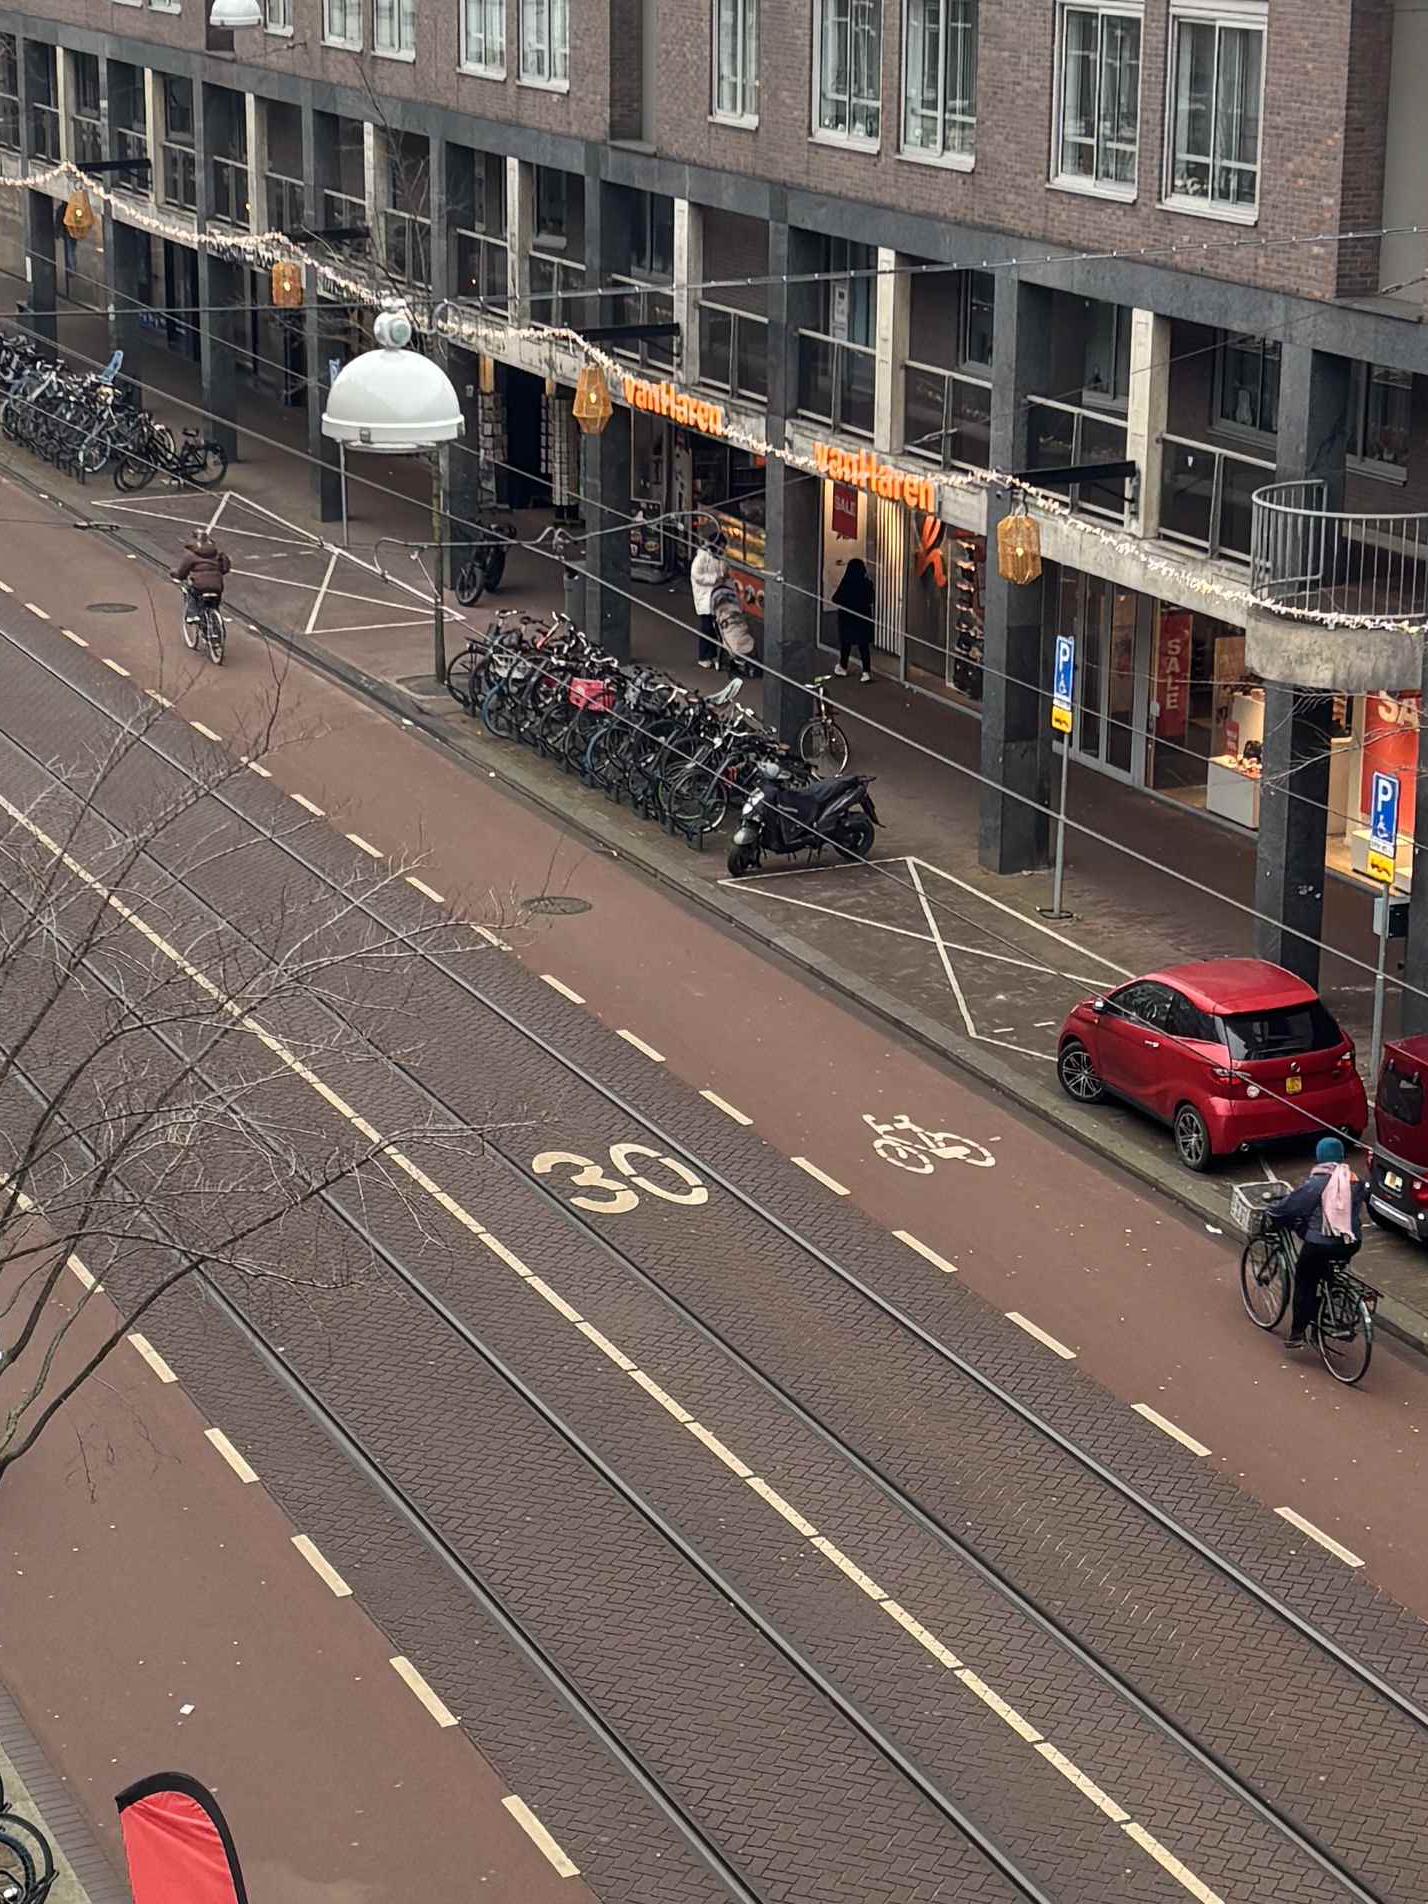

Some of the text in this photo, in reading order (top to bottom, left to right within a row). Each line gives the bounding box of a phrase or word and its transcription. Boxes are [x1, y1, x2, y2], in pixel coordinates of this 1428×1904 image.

[623, 376, 723, 436] vanHaren
[813, 441, 936, 513] vanHaren
[1166, 640, 1181, 711] SALE
[532, 1143, 708, 1215] 30
